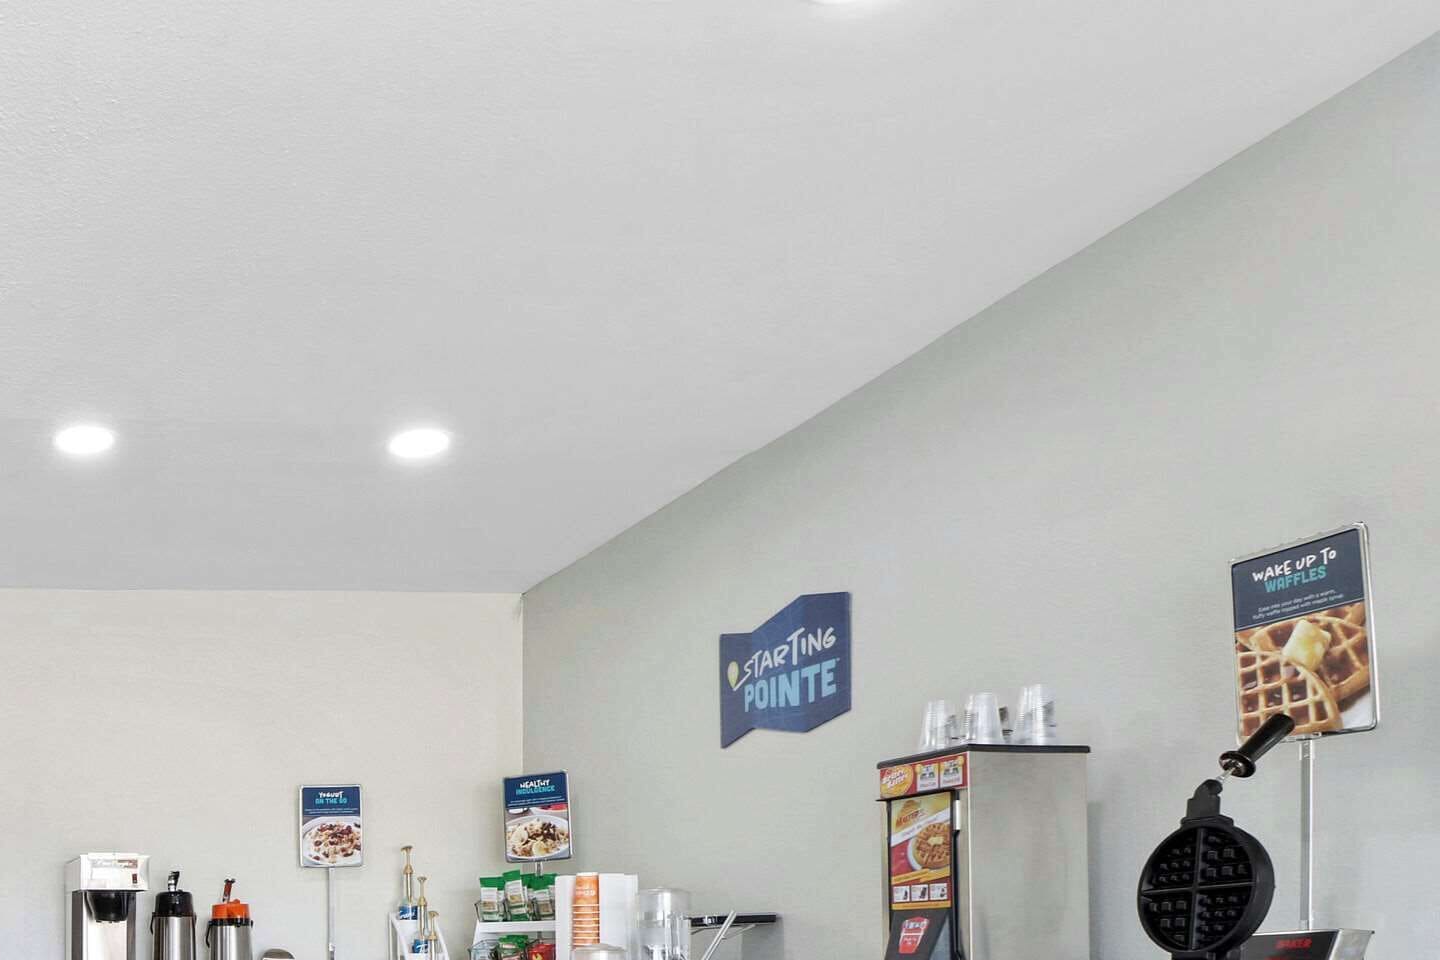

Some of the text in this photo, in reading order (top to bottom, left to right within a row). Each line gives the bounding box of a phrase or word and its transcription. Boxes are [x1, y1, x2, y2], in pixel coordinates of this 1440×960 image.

[1252, 560, 1292, 582] WAKE
[1296, 555, 1316, 570] UP
[1264, 565, 1327, 592] WAFFLES
[739, 627, 837, 680] STARTING
[744, 658, 837, 713] POINTE
[520, 779, 550, 789] HEALTHY
